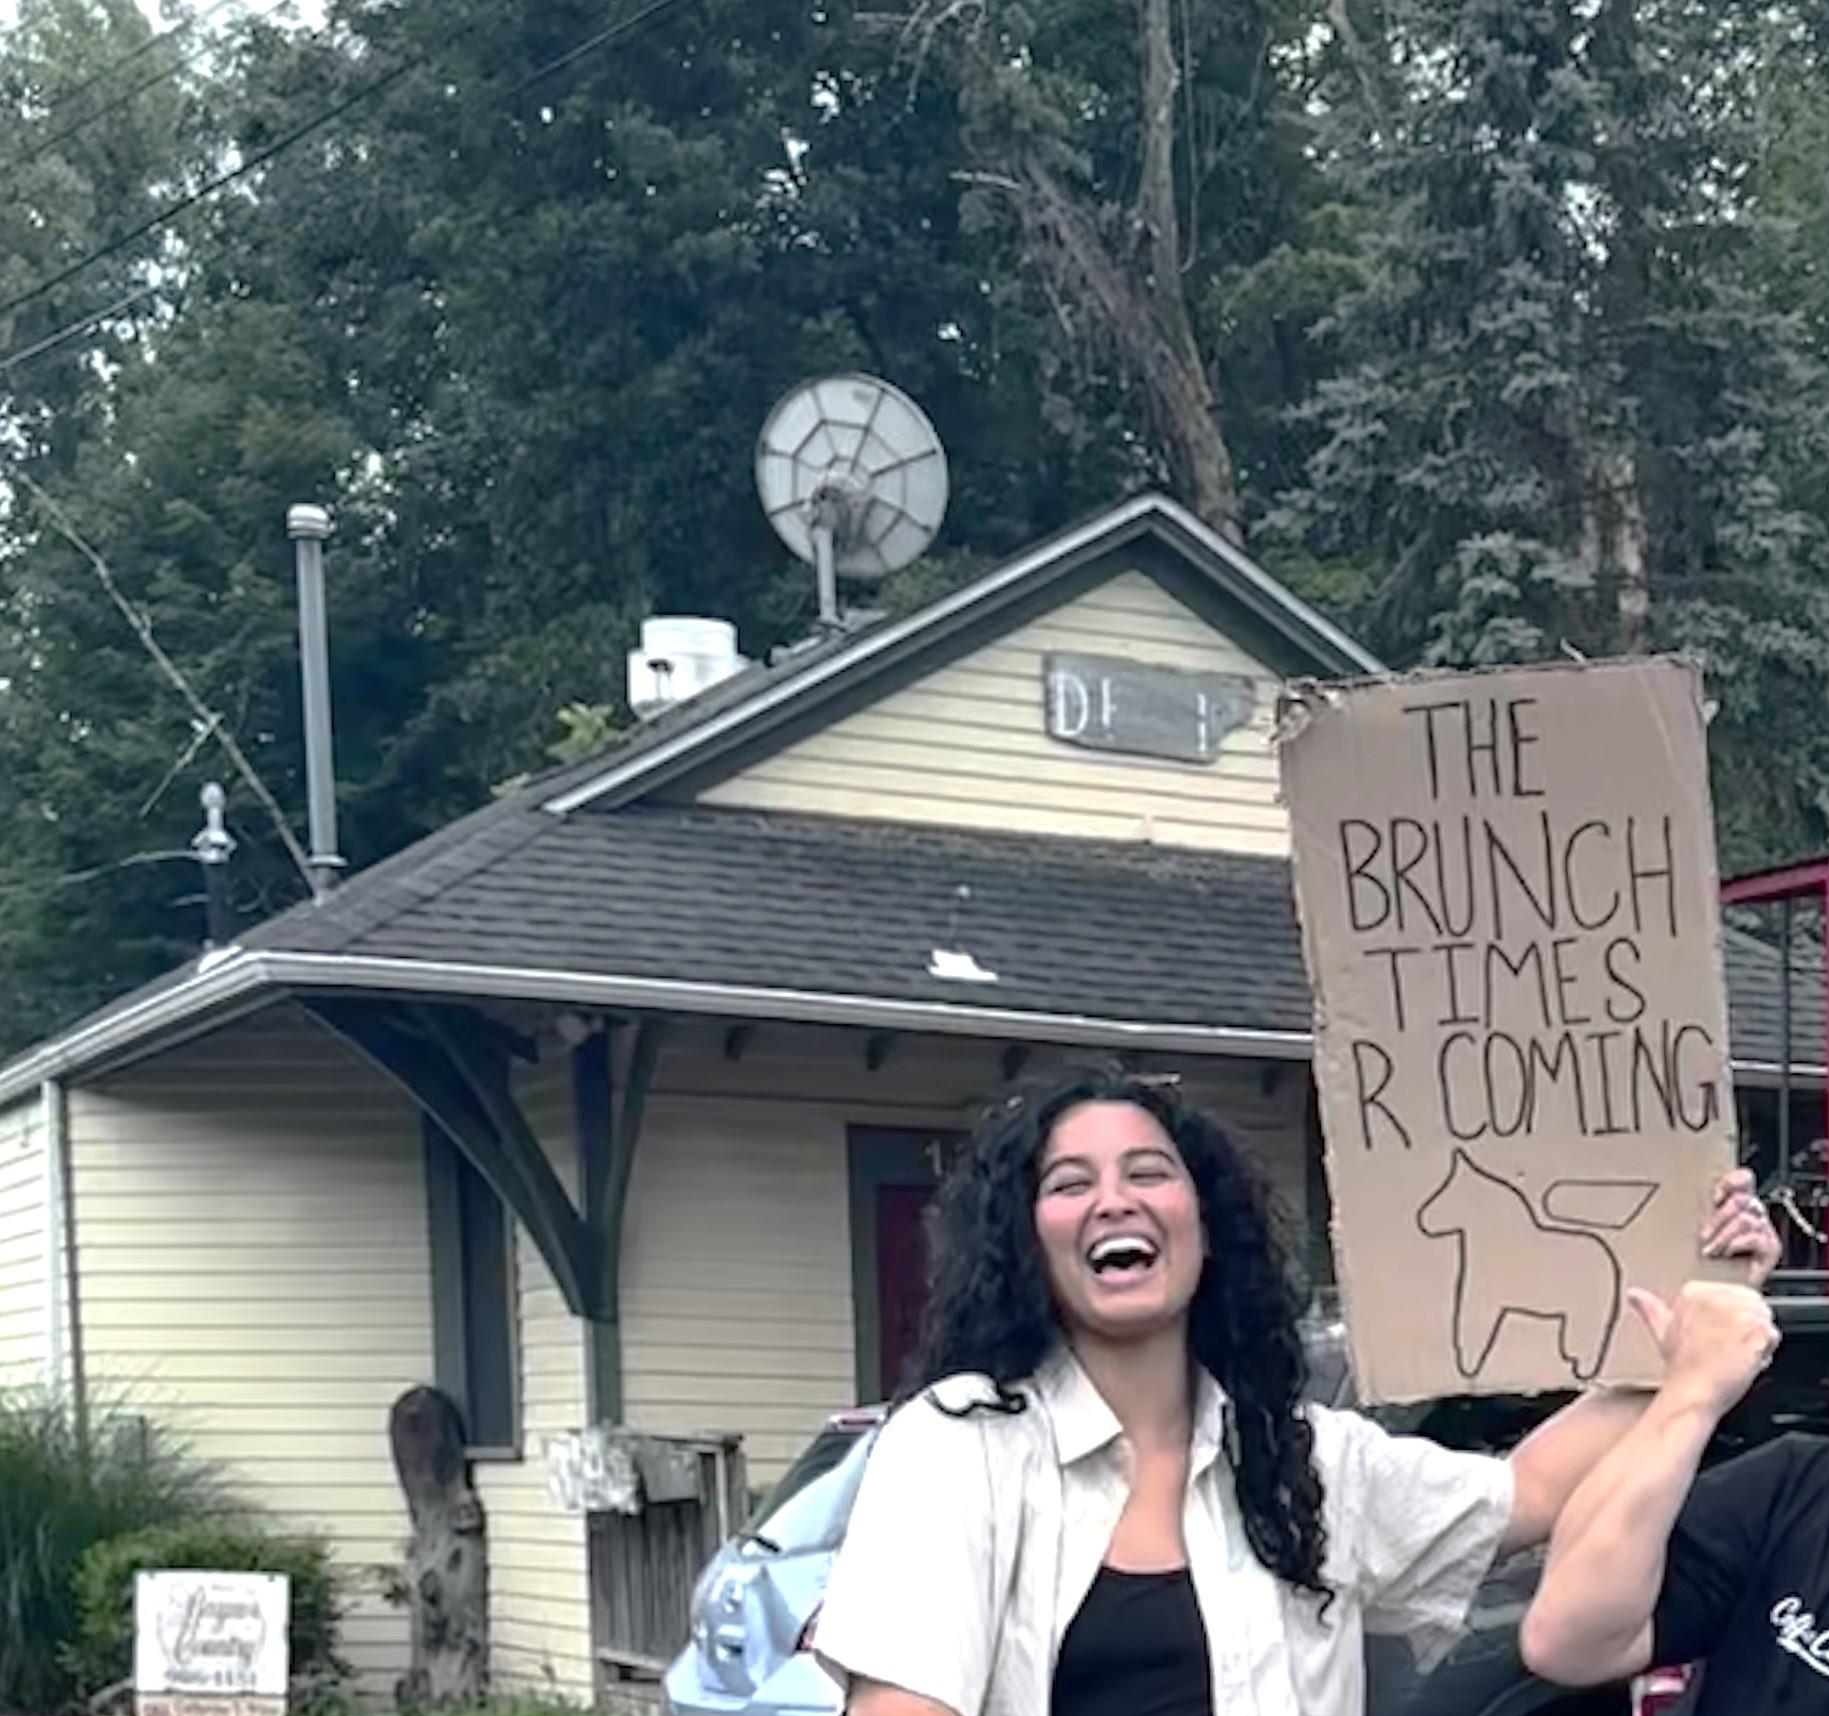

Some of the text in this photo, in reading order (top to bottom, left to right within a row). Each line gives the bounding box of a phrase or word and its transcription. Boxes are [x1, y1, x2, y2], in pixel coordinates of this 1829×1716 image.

[1405, 698, 1546, 800] THE
[1340, 811, 1680, 939] BRUNCH
[1364, 937, 1648, 1033] TIMES
[1352, 1019, 1721, 1151] R COMING
